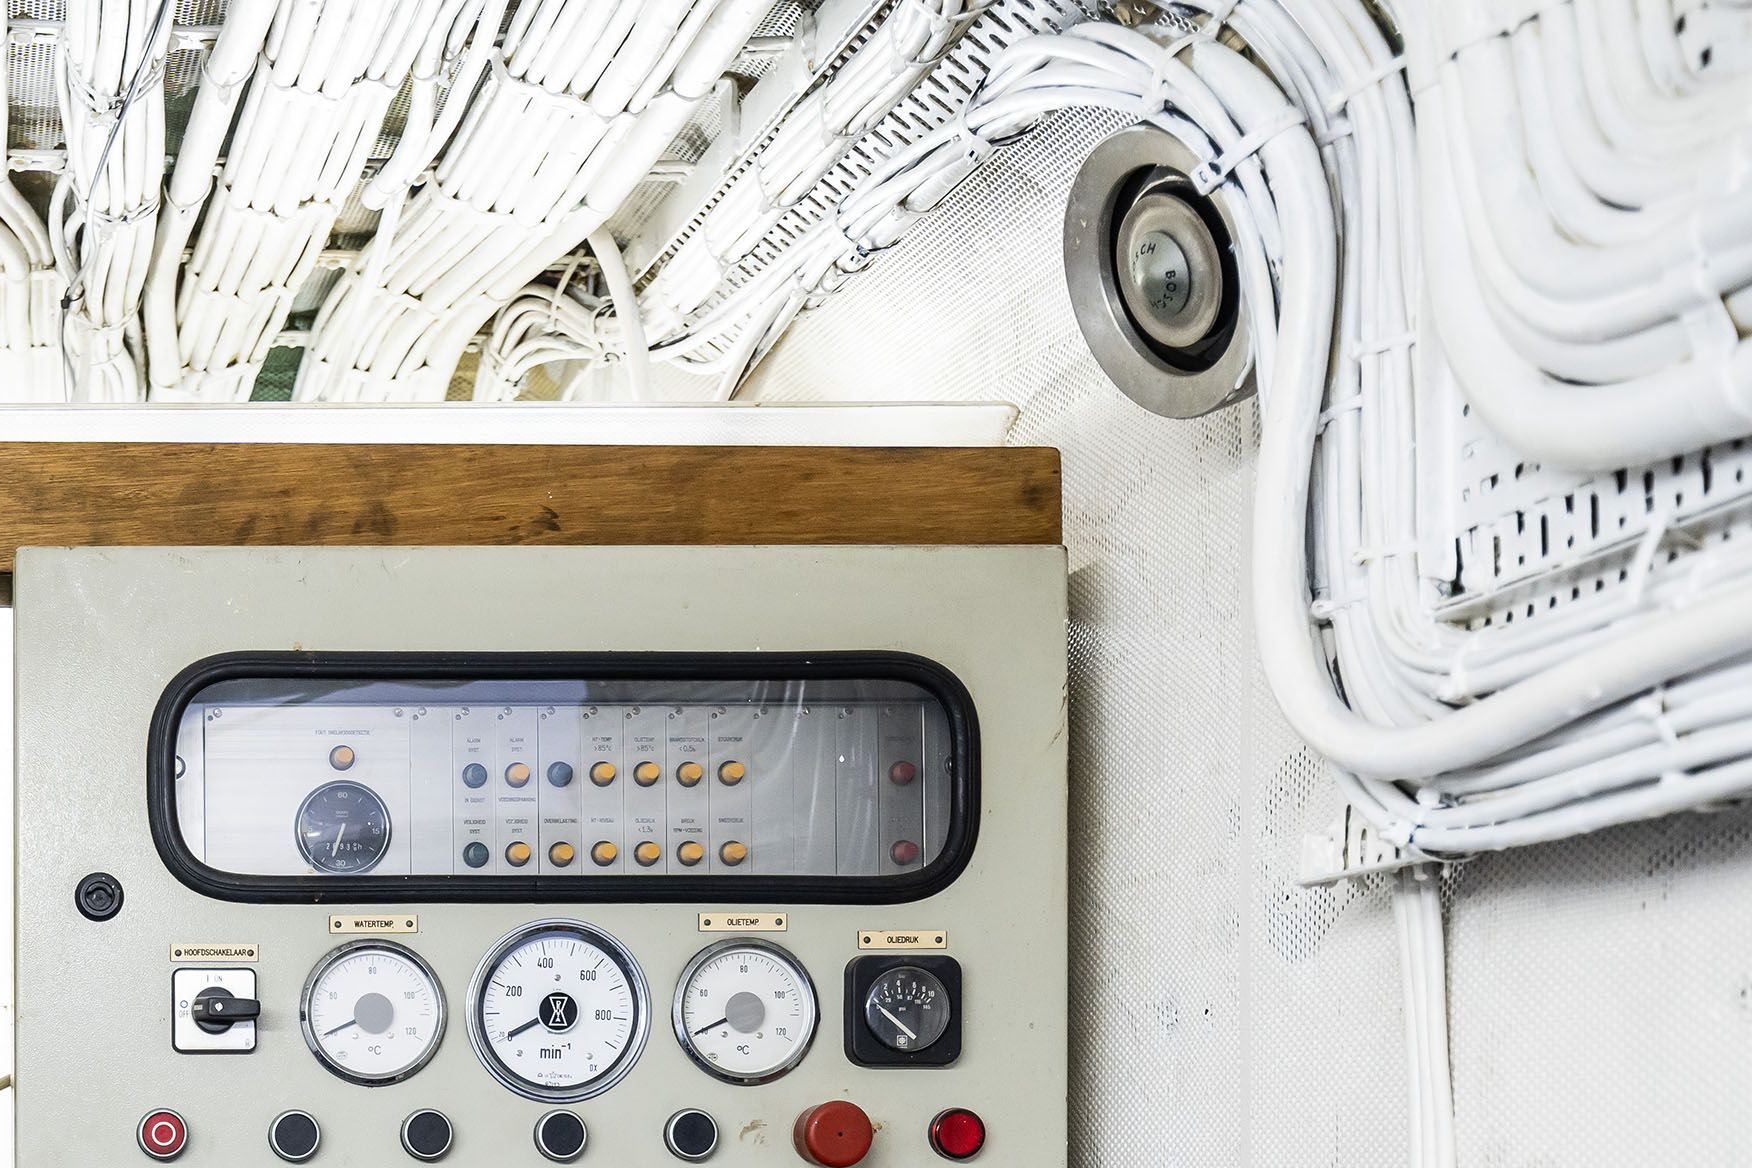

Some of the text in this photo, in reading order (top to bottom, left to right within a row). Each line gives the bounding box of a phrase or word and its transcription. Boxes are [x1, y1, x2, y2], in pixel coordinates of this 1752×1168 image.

[354, 921, 394, 929] WATERTEMP.
[887, 936, 919, 944] OLIEDRUK
[184, 948, 246, 956] HOOFDSCHAKELAAR
[537, 958, 553, 968] 400
[368, 967, 377, 975] 80
[580, 970, 596, 981] 600
[506, 986, 522, 996] 200
[700, 989, 708, 997] 60
[774, 991, 785, 999] 100
[404, 992, 415, 1000] 100
[595, 1010, 611, 1020] 800
[406, 1027, 416, 1035] 120
[776, 1028, 786, 1036] 120
[368, 1046, 381, 1055] °C
[737, 1045, 749, 1055] °C
